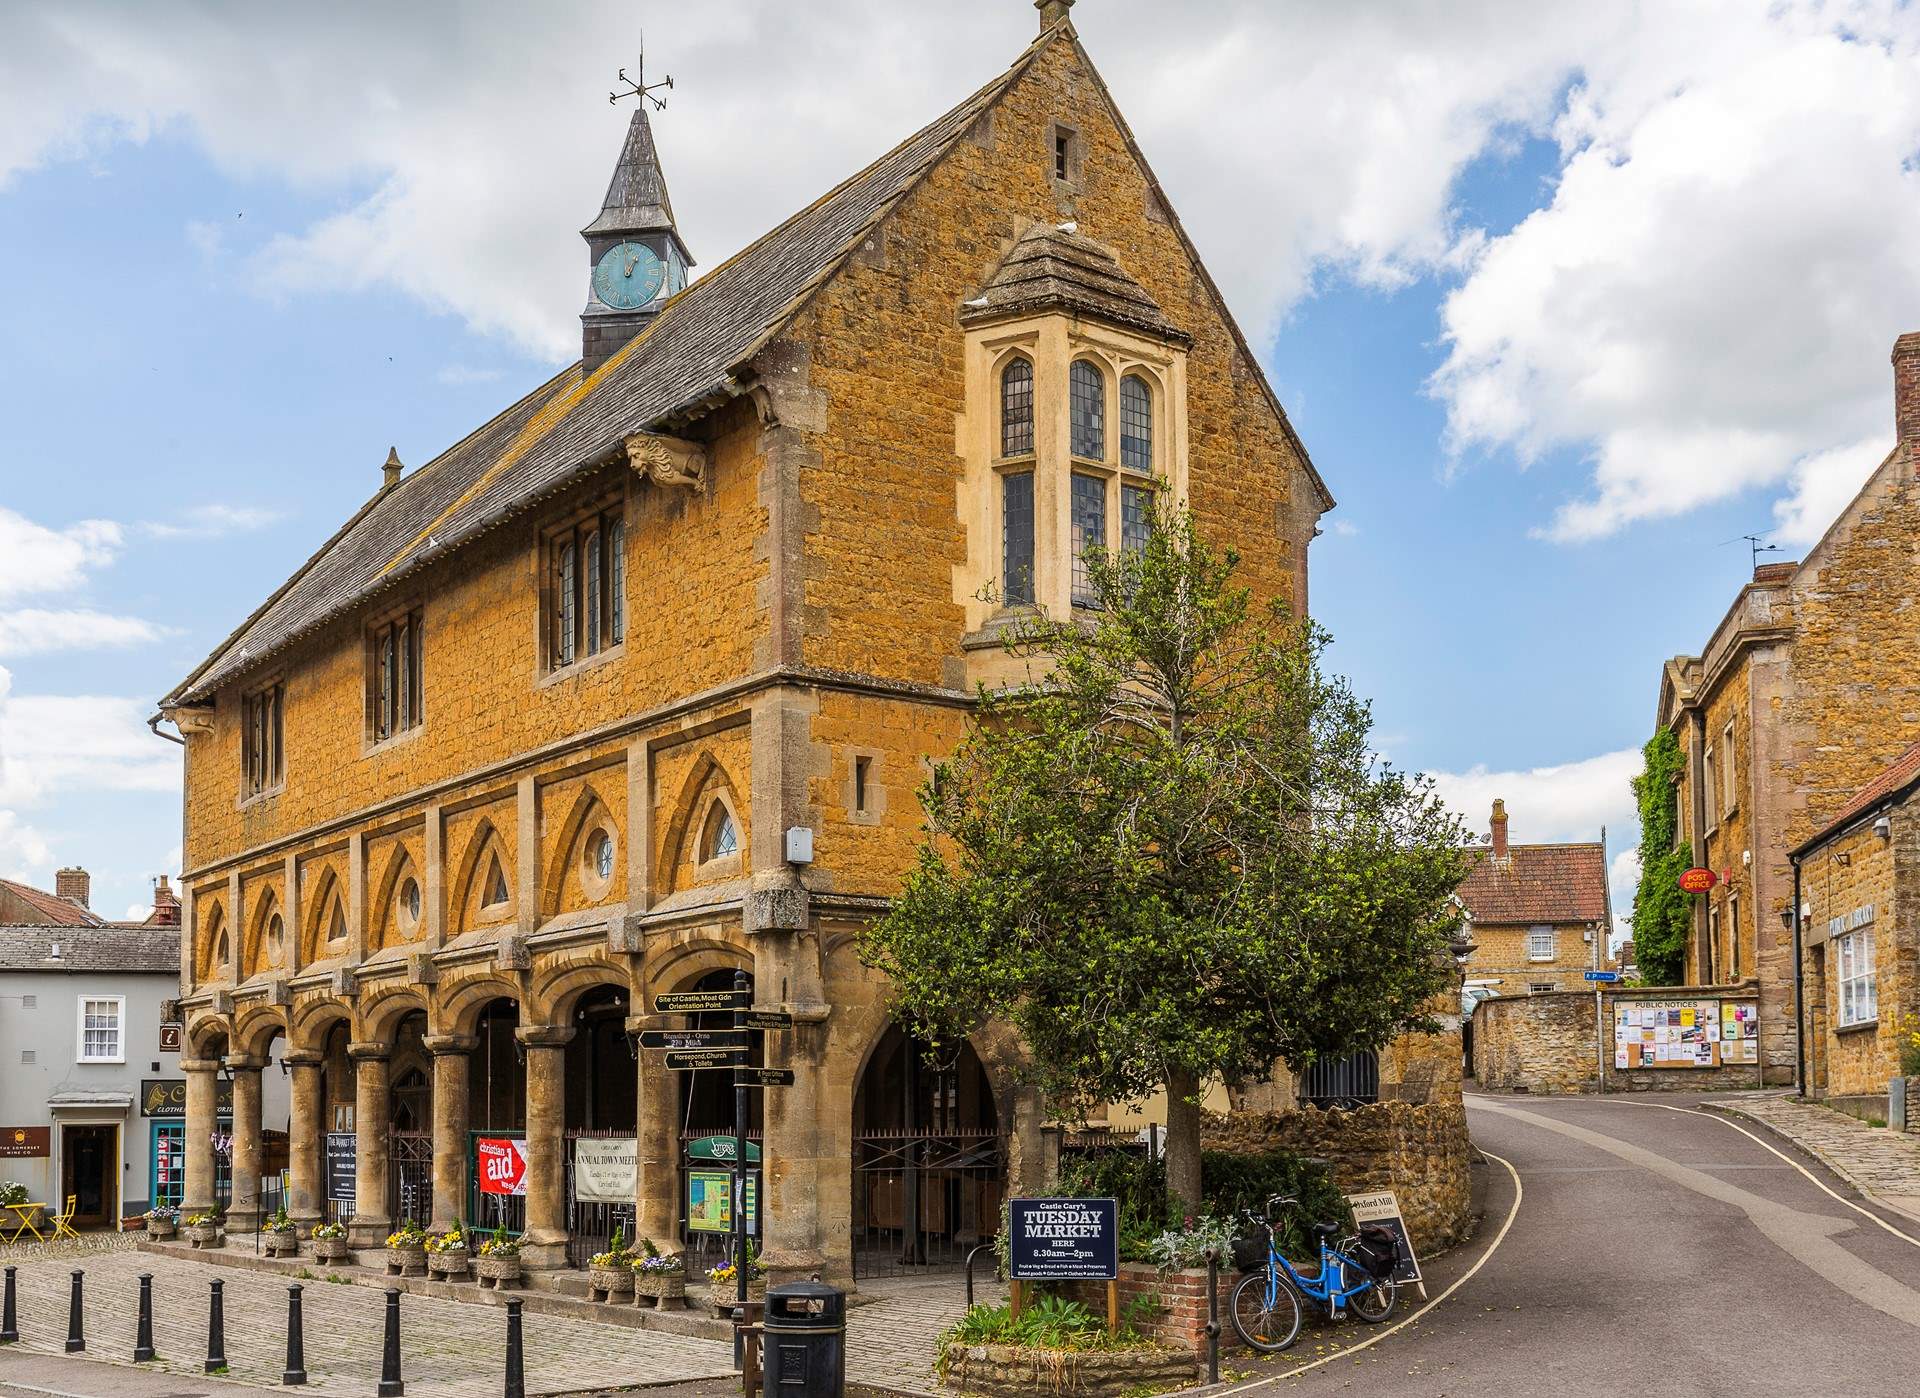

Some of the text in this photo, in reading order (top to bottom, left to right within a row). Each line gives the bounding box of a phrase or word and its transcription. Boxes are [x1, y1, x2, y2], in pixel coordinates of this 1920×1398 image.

[1687, 873, 1708, 881] POST
[1684, 881, 1711, 889] OFFICE
[480, 1142, 505, 1156] christian
[487, 1148, 514, 1180] aid
[577, 1155, 600, 1165] ANNUAL
[600, 1155, 618, 1165] TOWN
[1063, 1203, 1086, 1211] Cary's
[1355, 1197, 1393, 1209] Oxford Mill
[1024, 1211, 1103, 1224] TUESDAY
[1024, 1225, 1102, 1238] MARKET
